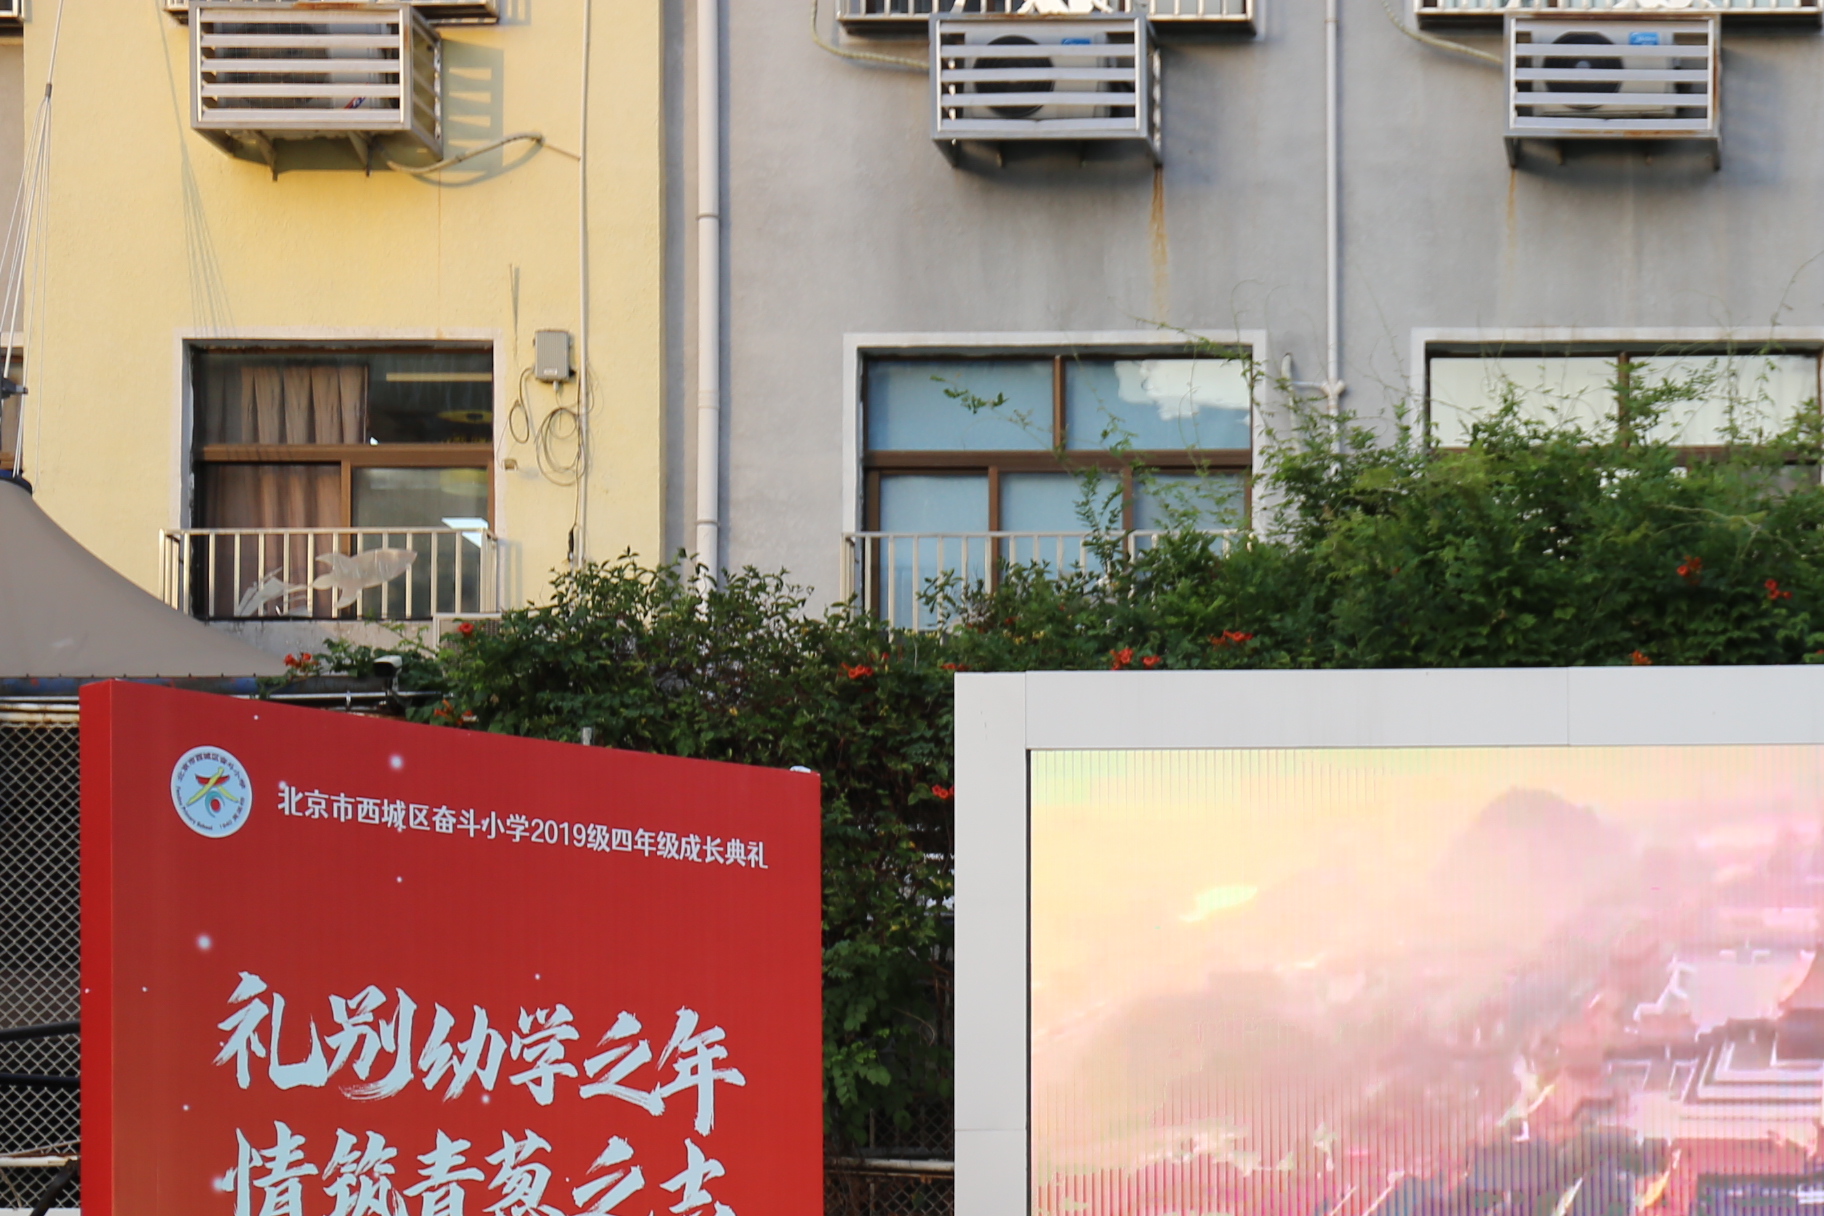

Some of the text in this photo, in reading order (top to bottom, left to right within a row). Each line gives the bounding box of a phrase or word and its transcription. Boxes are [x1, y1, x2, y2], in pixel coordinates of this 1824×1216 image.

[277, 784, 769, 870] 北京市西城区奋斗小学2019级四年级成长典礼
[213, 970, 746, 1136] 礼别幼学之年
